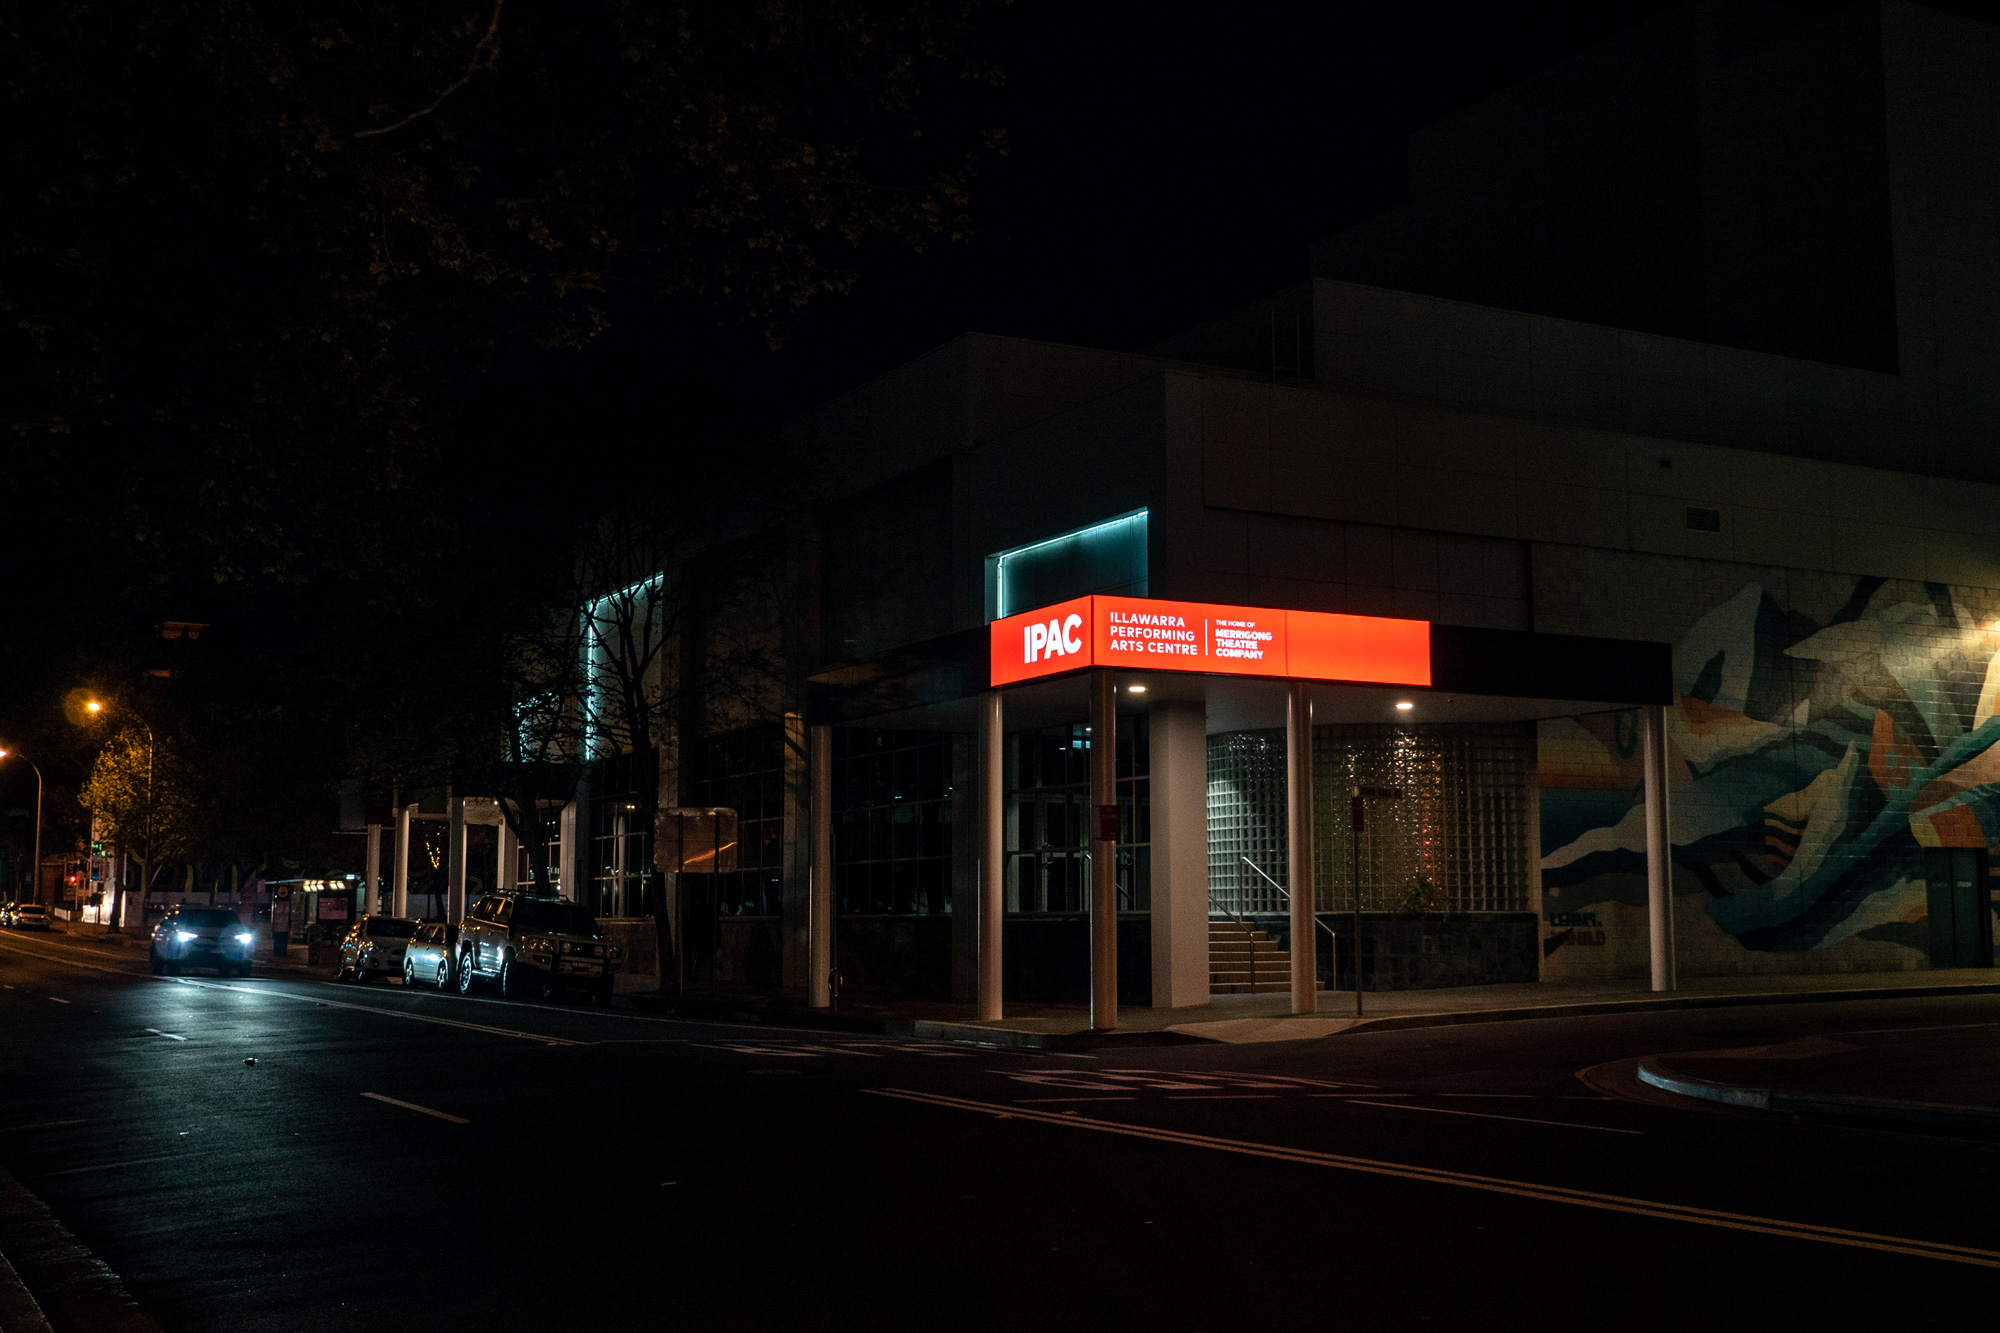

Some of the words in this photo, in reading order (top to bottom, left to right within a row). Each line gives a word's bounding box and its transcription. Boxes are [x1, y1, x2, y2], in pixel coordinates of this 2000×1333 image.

[1110, 611, 1186, 628] ILLAWARRA
[1216, 619, 1228, 627] THE
[1228, 620, 1246, 628] HOME
[1246, 621, 1256, 629] OF
[1024, 614, 1082, 664] IPAC
[1110, 625, 1196, 642] PERFORMING
[1215, 628, 1273, 641] MERRIGONG
[1110, 639, 1144, 652] ARTS
[1147, 641, 1198, 656] CENTRE
[1215, 638, 1258, 650] THEATRE
[1215, 648, 1264, 660] COMPANY
